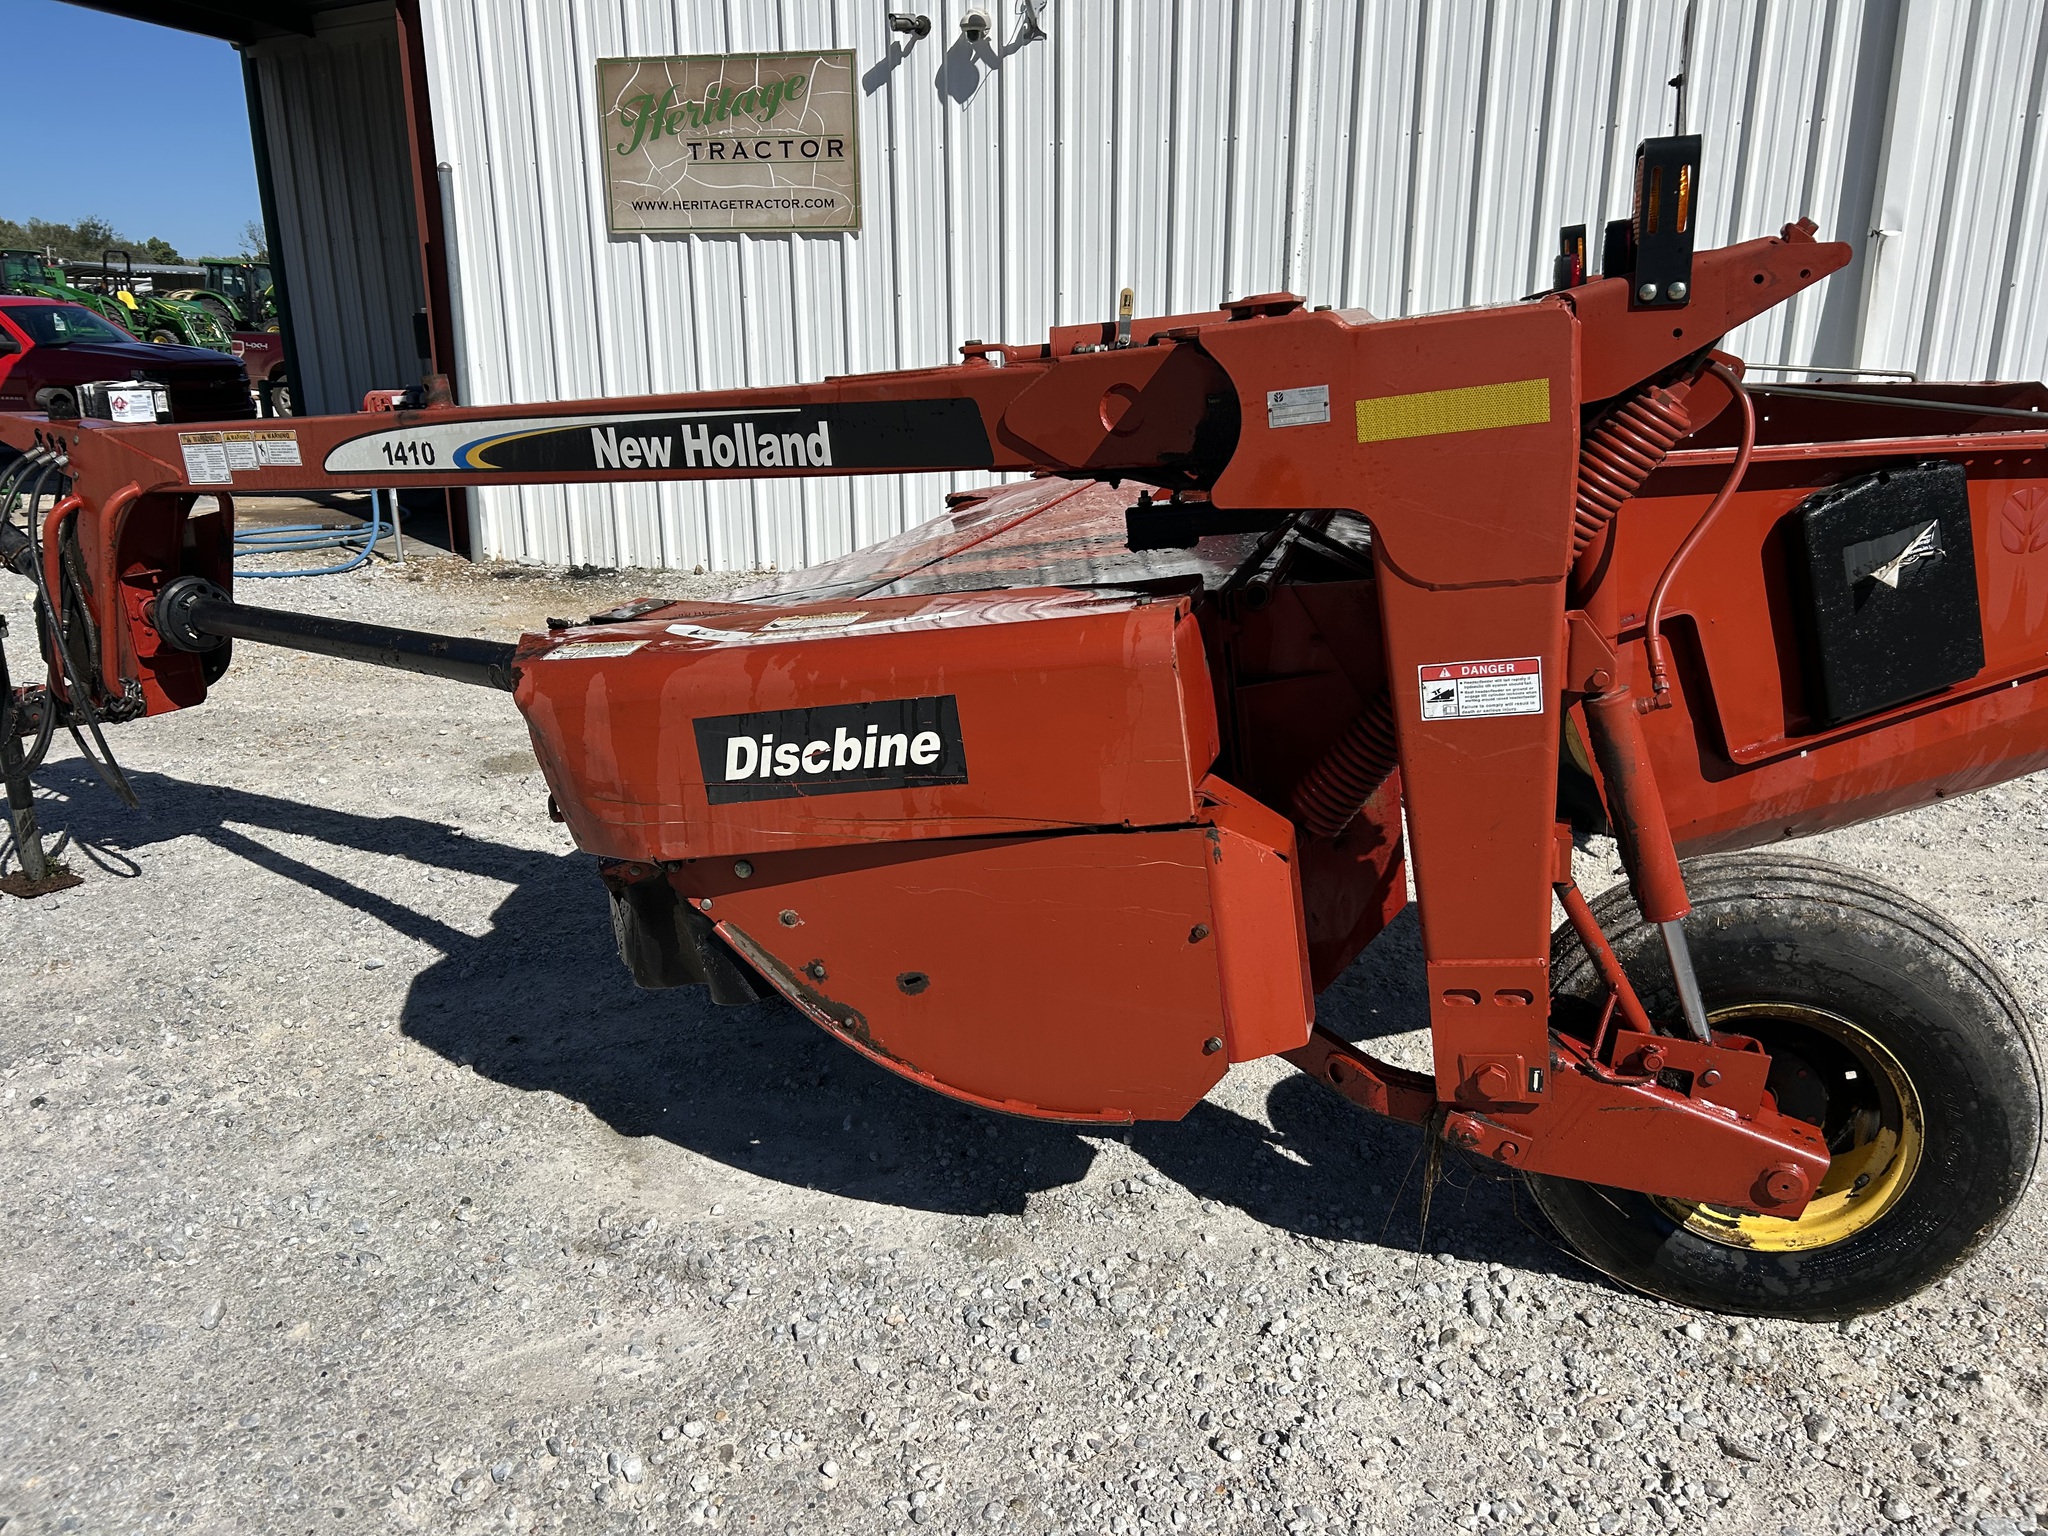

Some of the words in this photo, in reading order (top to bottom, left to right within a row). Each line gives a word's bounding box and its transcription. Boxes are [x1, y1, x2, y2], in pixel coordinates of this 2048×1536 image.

[617, 75, 809, 156] Heritage
[687, 139, 844, 160] TRACTOR
[631, 198, 835, 211] WWW.HERITAGETRACTOR.COM
[382, 441, 434, 467] 1410
[590, 424, 672, 469] New
[681, 420, 833, 468] Holland
[1461, 664, 1515, 675] DANGER
[725, 724, 941, 781] Discbine
